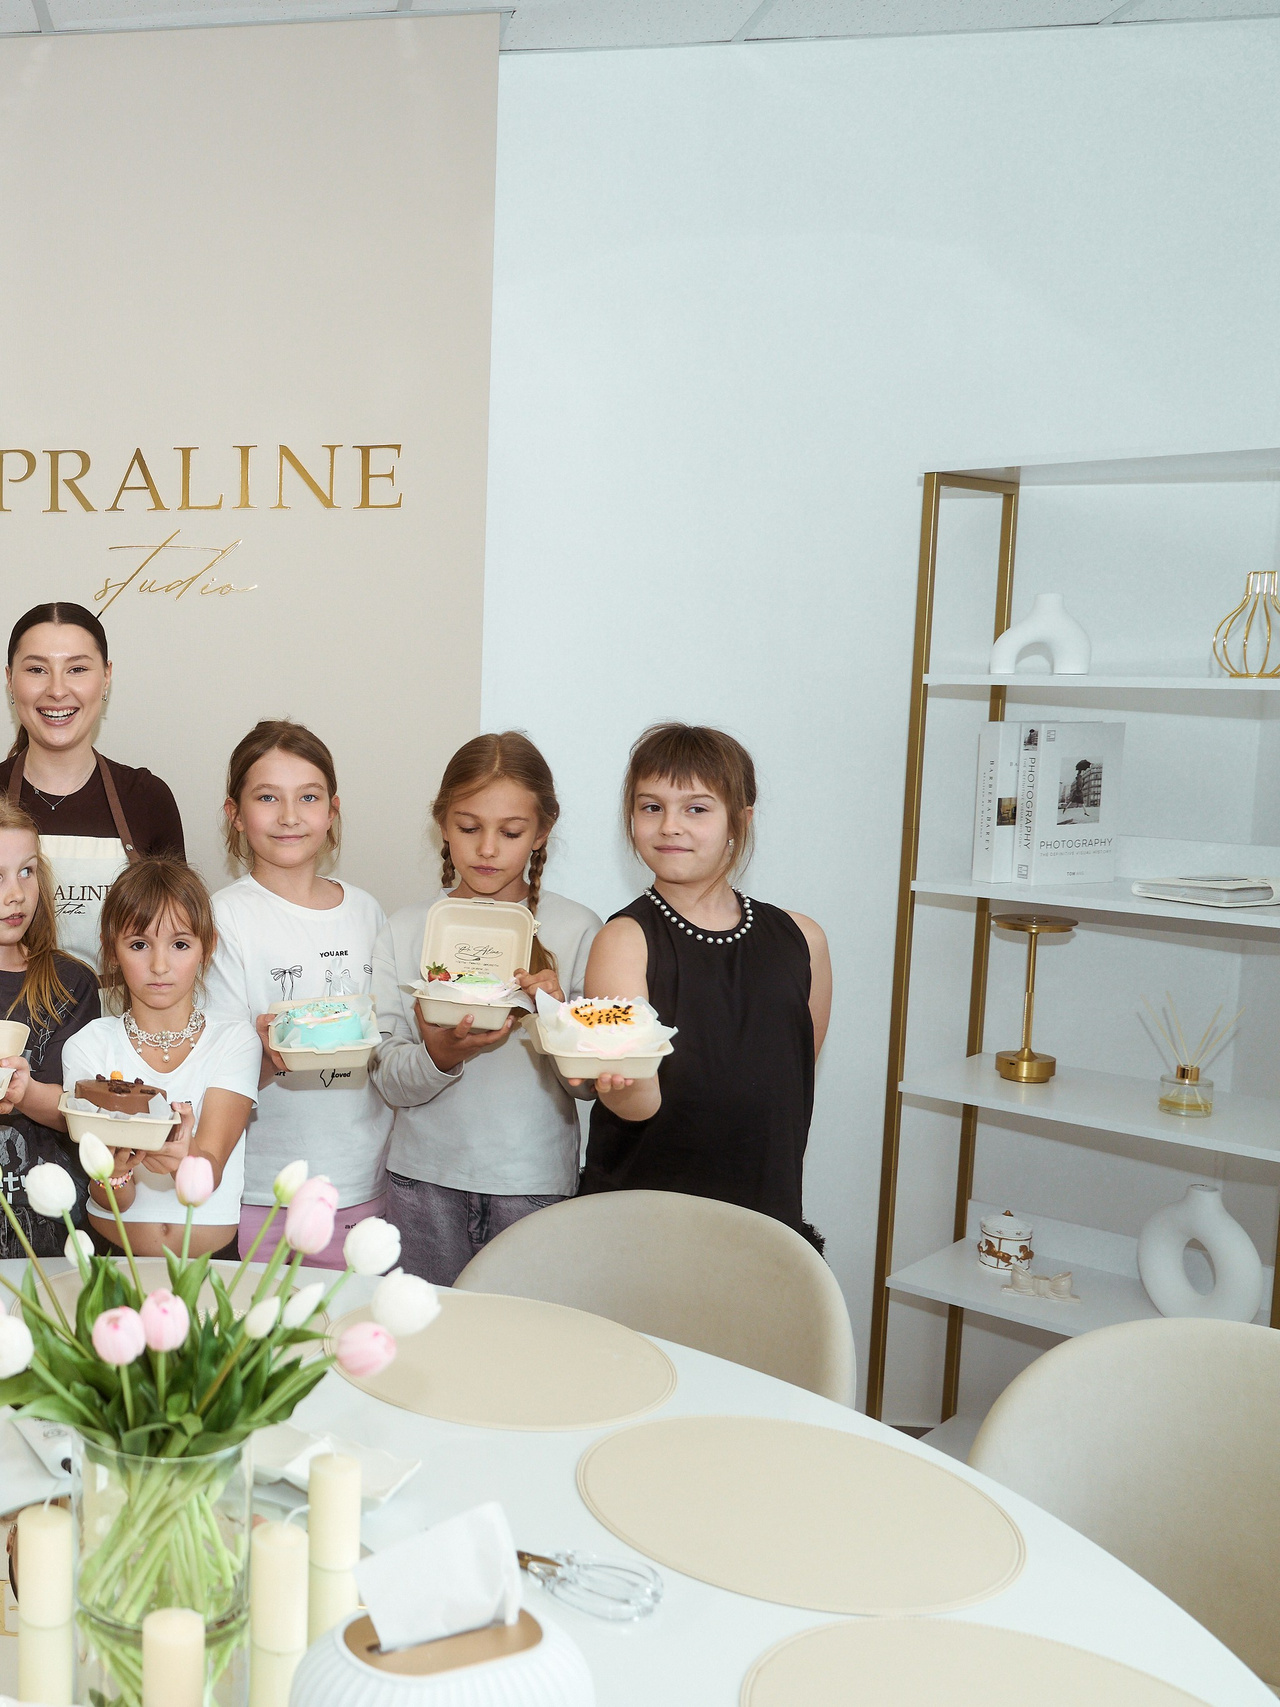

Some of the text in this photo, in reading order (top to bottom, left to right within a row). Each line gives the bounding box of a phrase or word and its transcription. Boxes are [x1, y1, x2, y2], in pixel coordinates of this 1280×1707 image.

[93, 528, 258, 620] studio
[1023, 757, 1037, 850] PHOTOGRAPHY
[1039, 838, 1113, 849] PHOTOGRAPHY
[54, 885, 113, 901] ALIN
